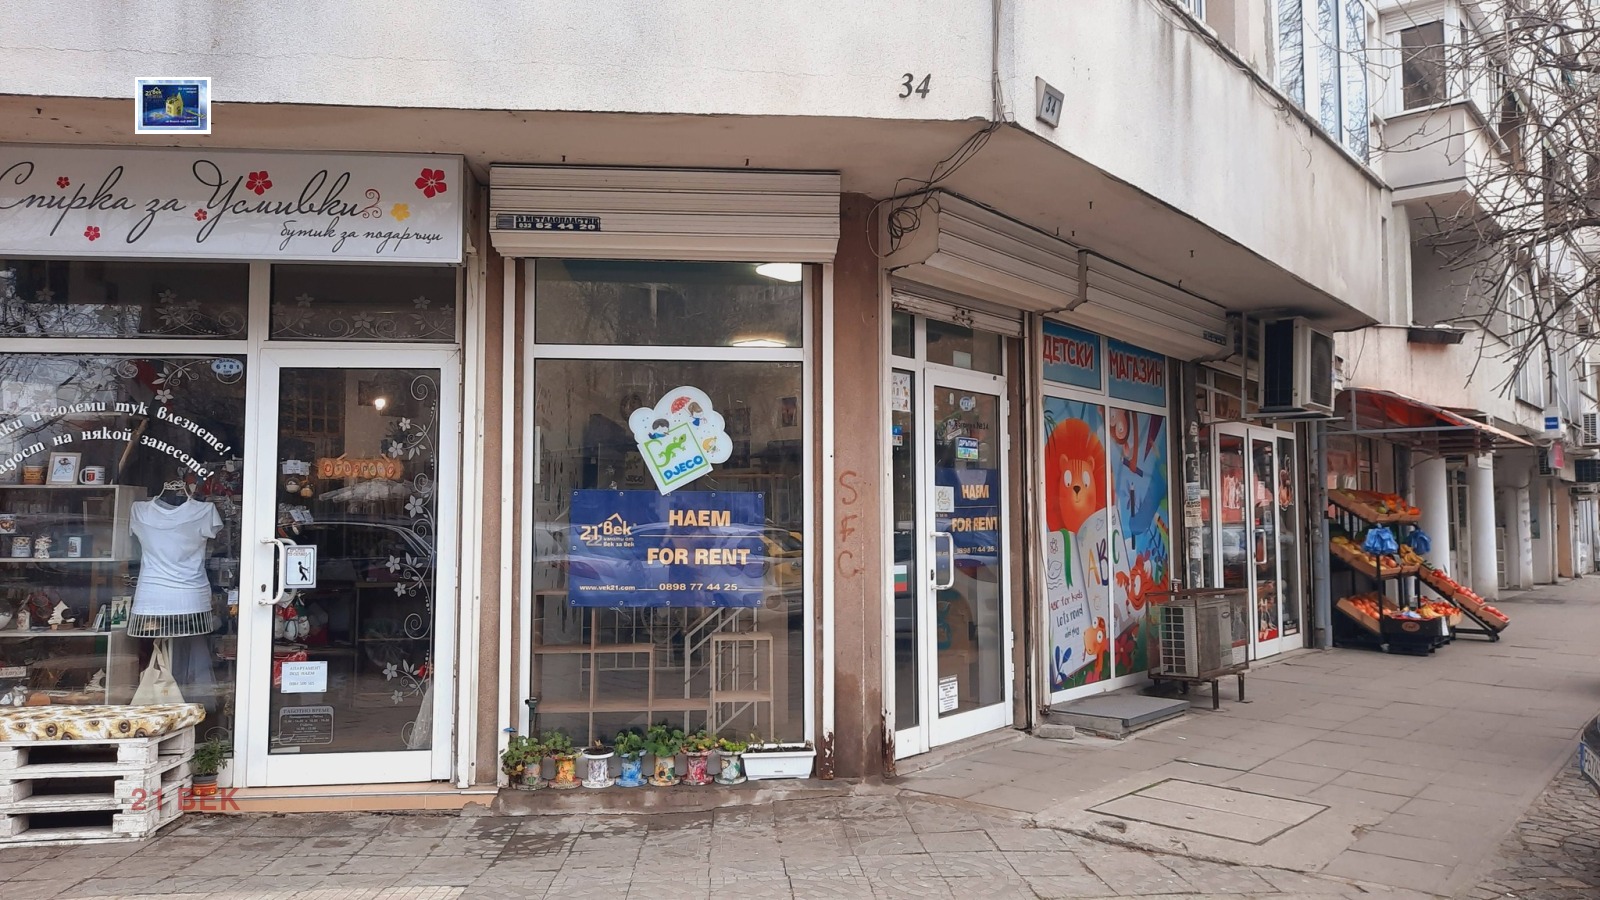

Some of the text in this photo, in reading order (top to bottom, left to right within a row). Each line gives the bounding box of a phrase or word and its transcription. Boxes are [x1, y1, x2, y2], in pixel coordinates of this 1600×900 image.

[899, 73, 931, 99] 34
[1045, 96, 1057, 117] 34
[126, 198, 187, 244] за
[192, 159, 364, 244] Усмивки
[280, 216, 337, 252] бутик
[332, 234, 359, 253] за
[1043, 334, 1162, 386] ДЕТСКИ МАГАЗИН
[31, 413, 42, 422] и
[50, 401, 106, 417] големи
[114, 401, 149, 417] тук
[157, 406, 231, 456] влезнете!
[53, 433, 73, 446] на
[81, 426, 132, 442] някой
[140, 434, 215, 481] занесете!
[663, 454, 704, 480] DJECO
[961, 484, 990, 499] НАЕМ
[668, 509, 731, 527] НАЕМ
[951, 517, 972, 533] FOR
[580, 525, 599, 540] 21
[647, 547, 750, 566] FOR RENT
[579, 584, 636, 592] www.vek21.com
[659, 583, 738, 592] 0898 77 44 25
